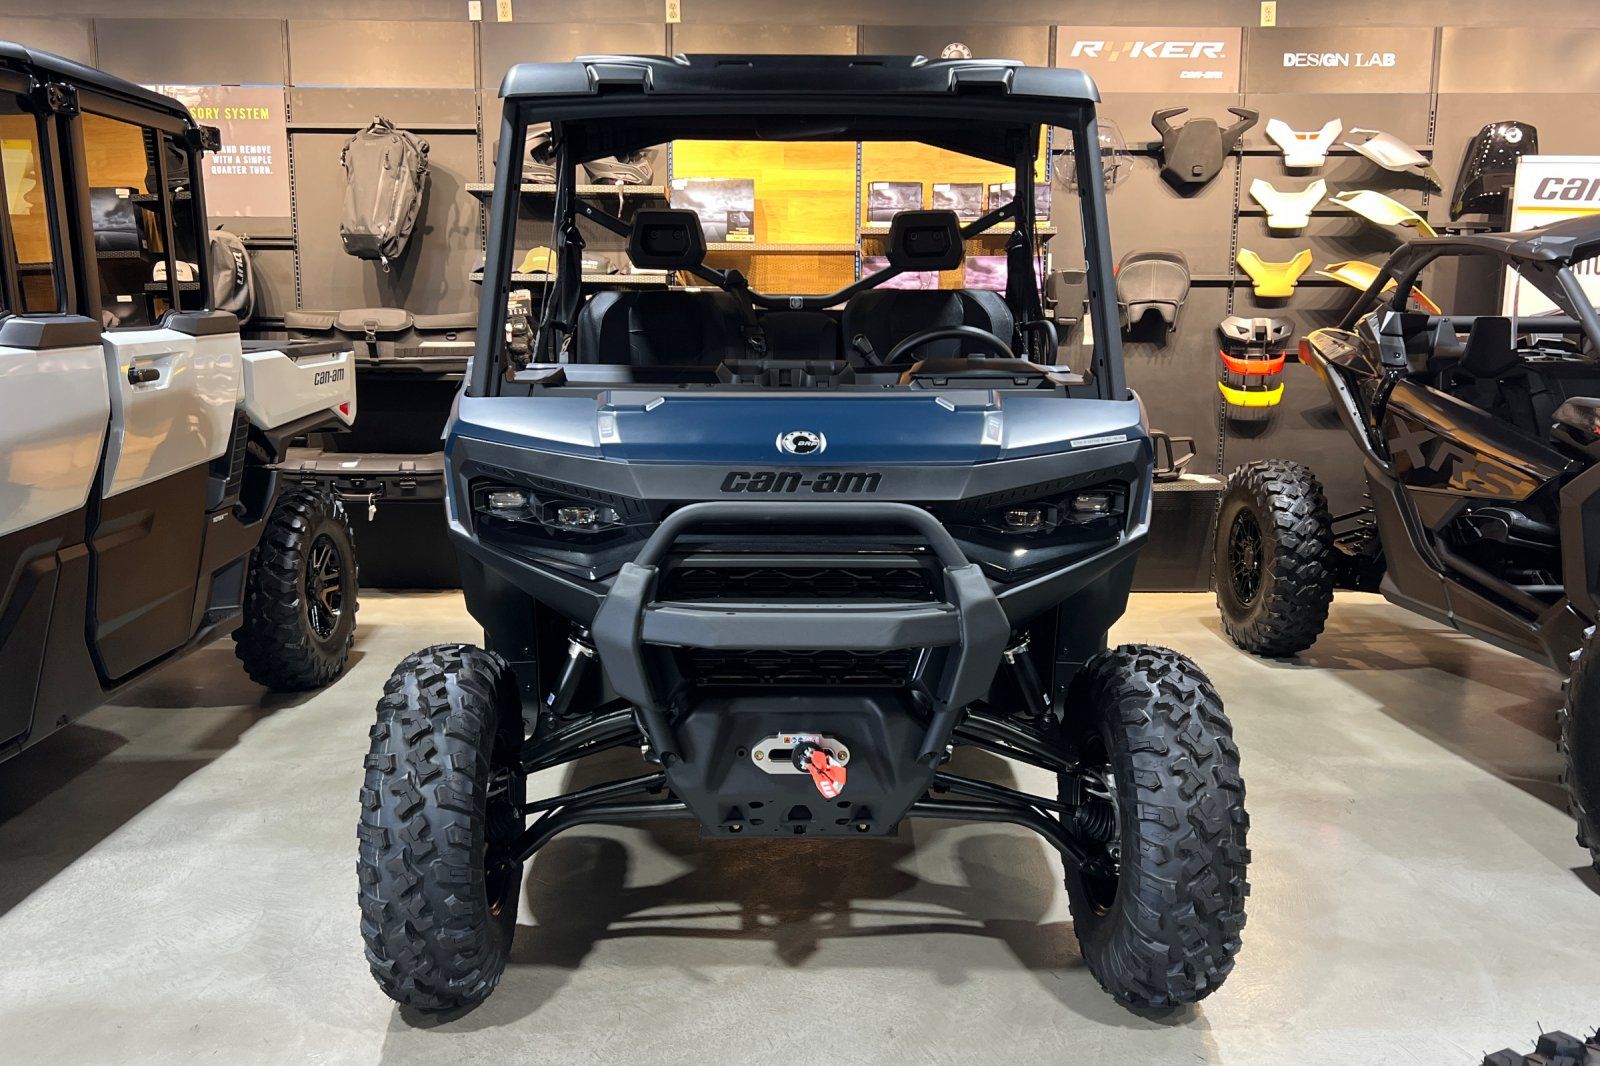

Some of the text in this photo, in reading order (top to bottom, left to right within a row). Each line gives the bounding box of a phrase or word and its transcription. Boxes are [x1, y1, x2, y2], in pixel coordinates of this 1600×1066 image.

[1283, 52, 1396, 67] DESIGN LAB
[224, 107, 270, 120] SYSTEM
[240, 145, 272, 154] REMOVE
[211, 155, 273, 165] WITH A SIMPLE
[211, 165, 247, 175] QUARTER
[314, 368, 345, 386] can-am
[720, 471, 883, 494] can-am
